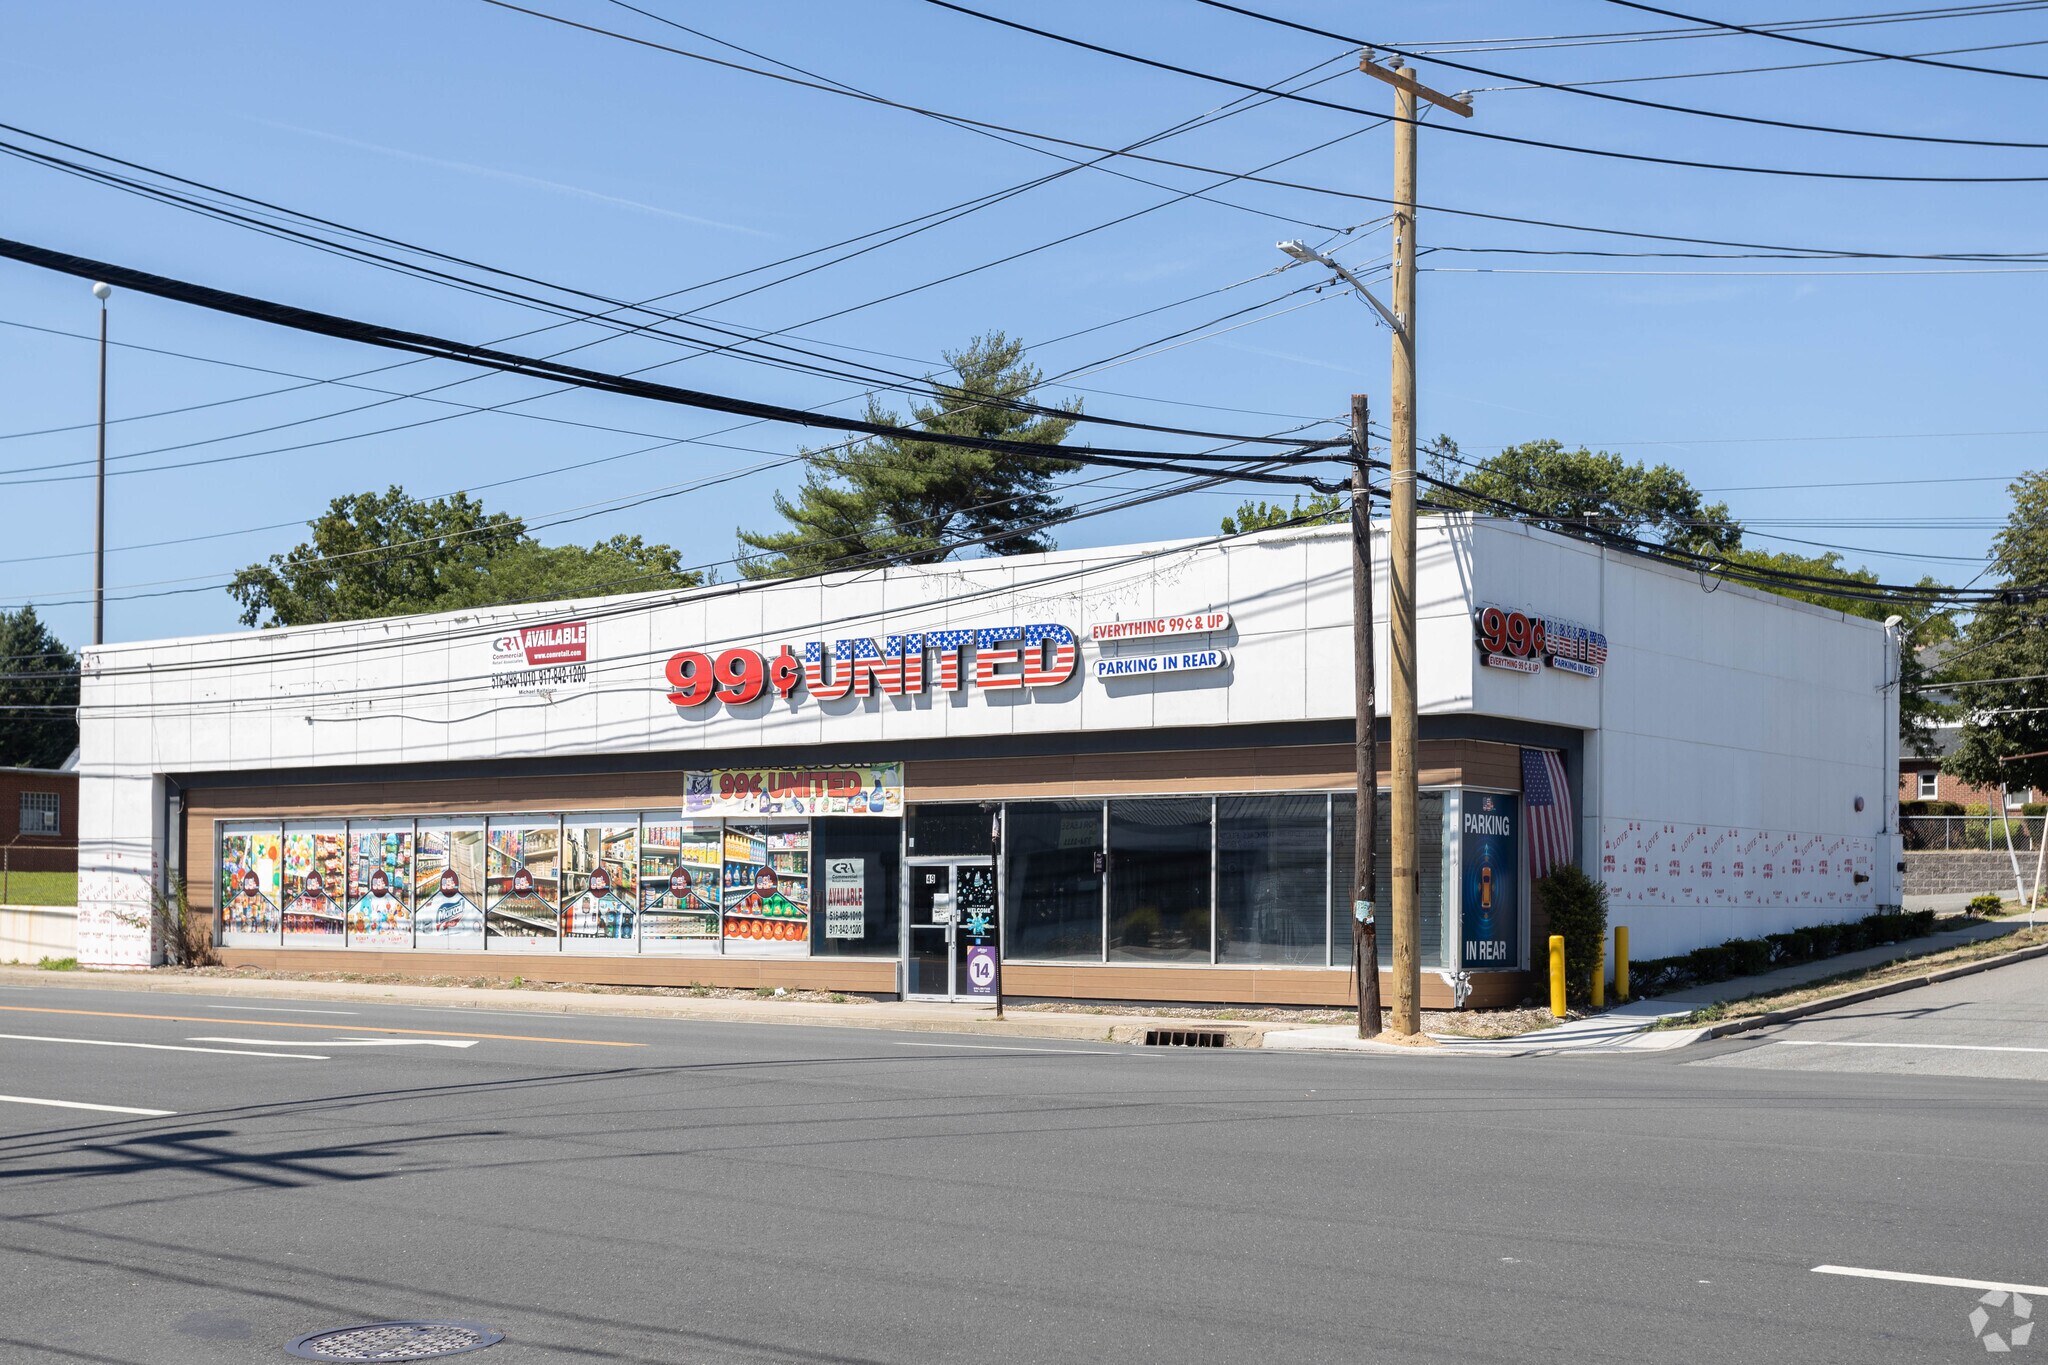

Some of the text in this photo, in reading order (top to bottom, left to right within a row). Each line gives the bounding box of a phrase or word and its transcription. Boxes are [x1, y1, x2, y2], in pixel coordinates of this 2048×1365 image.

[1093, 614, 1224, 639] EVERYTHING 99¢ & UP
[1481, 607, 1608, 665] 99¢ UNITED
[525, 626, 586, 648] AVAILABLE
[492, 652, 523, 660] Commercial
[665, 624, 1077, 707] 99¢ UNITED
[1099, 652, 1217, 676] PARKING IN REAR
[1490, 656, 1518, 669] EVERYTHING
[1554, 657, 1598, 677] PARKING IN REAR
[720, 770, 862, 800] 99¢ UNITED
[1464, 813, 1510, 836] PARKING
[1612, 830, 1629, 850] LOVE
[1645, 831, 1660, 853] LOVE
[1681, 832, 1695, 853] LOVE
[1710, 834, 1724, 854] LOVE
[1744, 836, 1758, 856] LOVE
[926, 875, 935, 884] 49
[828, 887, 862, 906] AVAILABLE
[1466, 941, 1507, 960] IN REAR
[974, 963, 990, 978] 14
